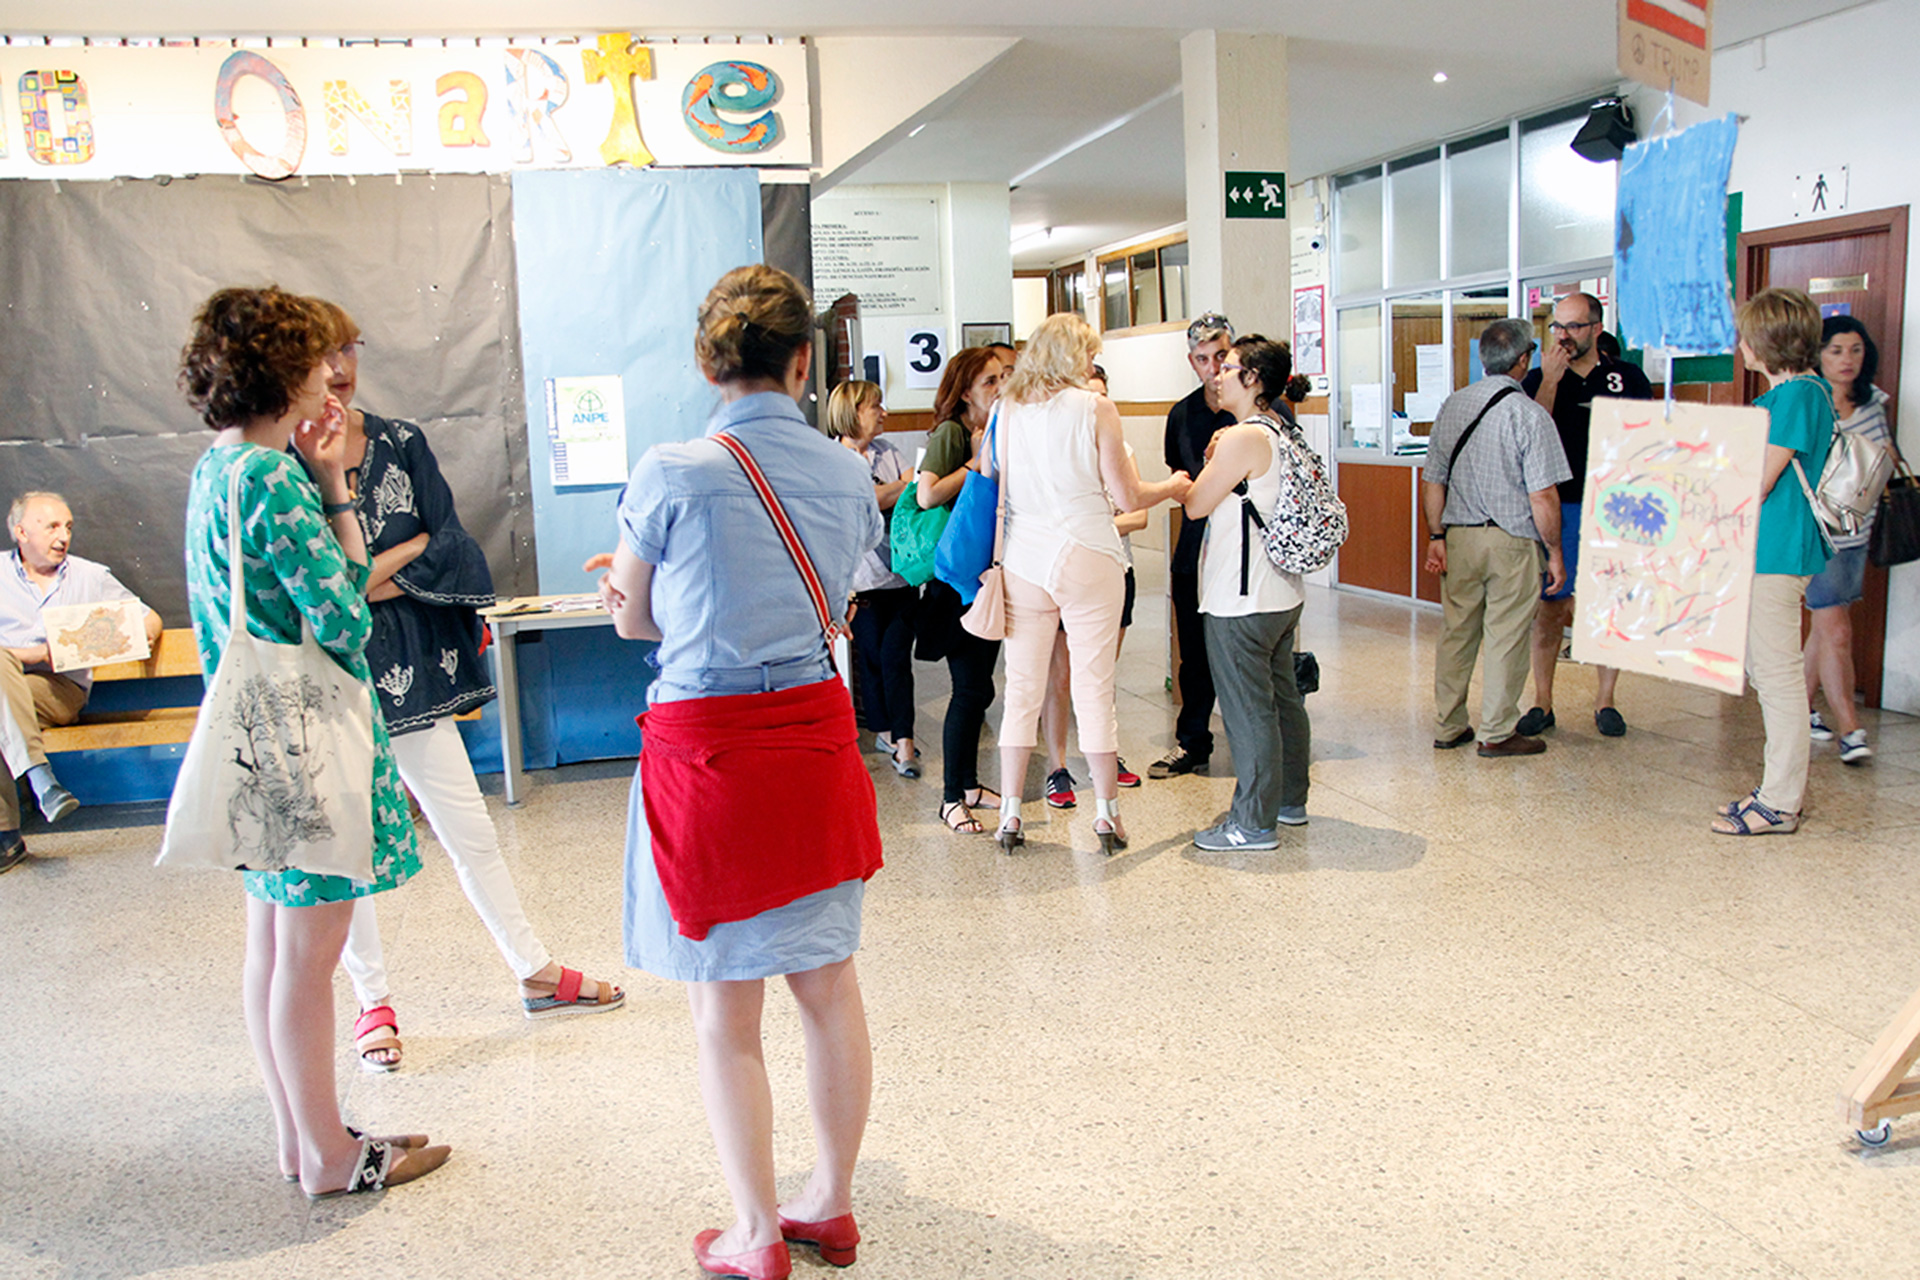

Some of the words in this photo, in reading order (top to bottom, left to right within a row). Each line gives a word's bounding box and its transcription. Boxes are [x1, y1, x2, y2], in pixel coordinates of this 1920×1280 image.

[909, 333, 941, 373] 3
[1606, 372, 1624, 393] 3
[572, 412, 609, 424] ANPE
